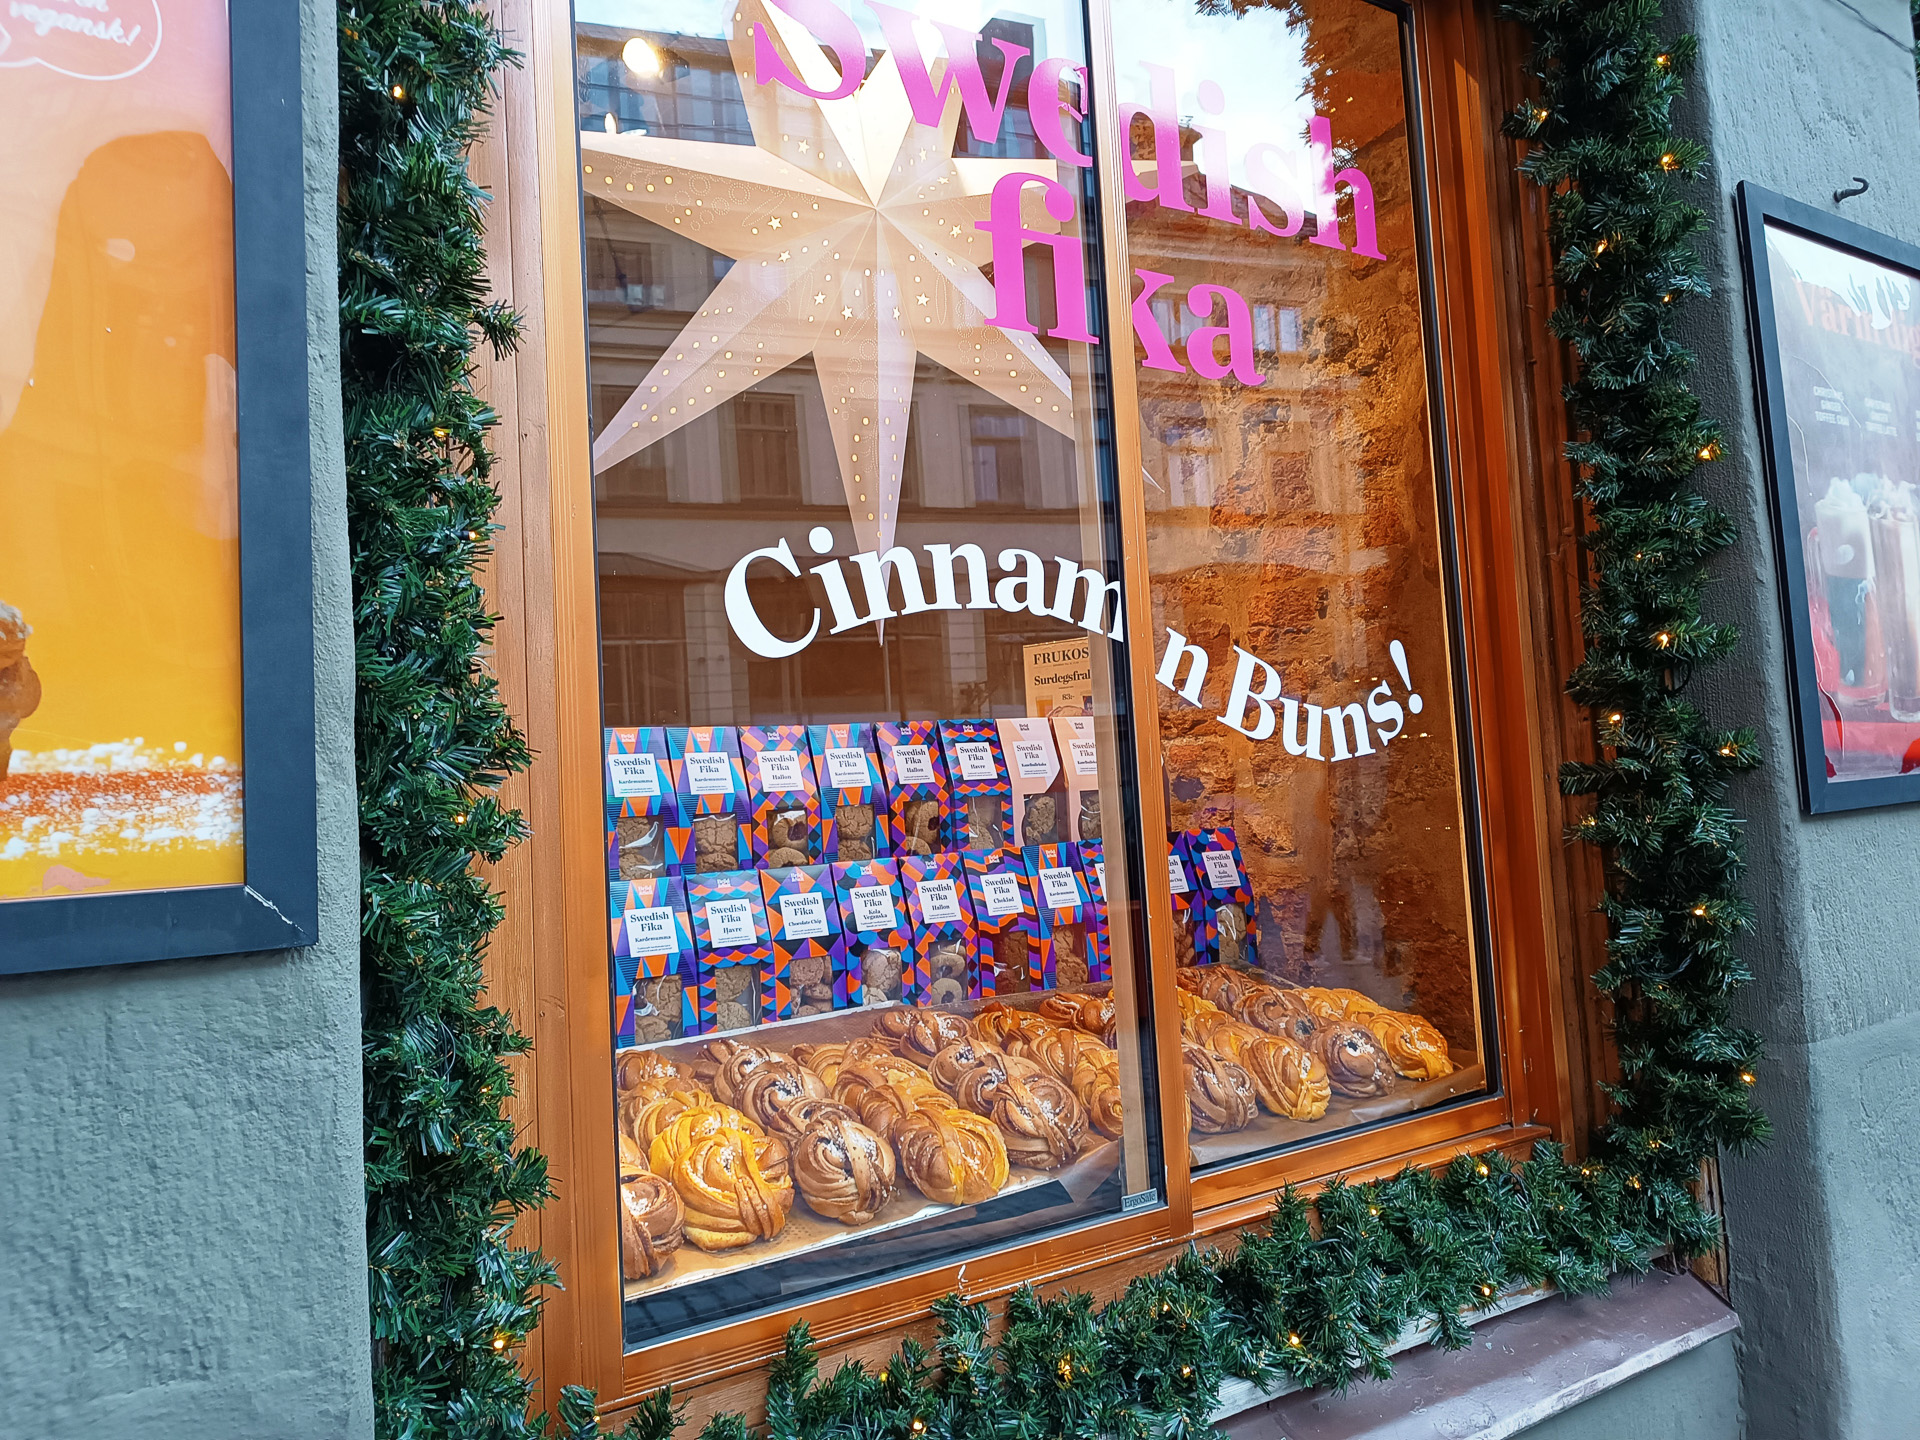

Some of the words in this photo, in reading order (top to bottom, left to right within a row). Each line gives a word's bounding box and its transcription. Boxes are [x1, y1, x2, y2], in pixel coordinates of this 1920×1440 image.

[754, 0, 1387, 260] Swedish
[975, 172, 1266, 386] fika
[724, 525, 1210, 708] Cinnamn
[1215, 639, 1423, 762] Buns!
[1033, 647, 1090, 666] FRUKOS
[1034, 669, 1091, 686] Surdegsfral
[896, 748, 926, 757] Swedish
[959, 745, 988, 753] Swedish
[1016, 744, 1043, 752] Swedish
[761, 754, 795, 763] Swedish
[829, 751, 862, 761] Swedish
[967, 753, 984, 761] Fika
[1024, 751, 1040, 759] Fika
[613, 757, 651, 767] Swedish
[690, 756, 725, 765] Swedish
[838, 759, 857, 769] Fika
[905, 756, 922, 765] Fika
[624, 765, 645, 775] Fika
[699, 764, 719, 774] Fika
[771, 763, 790, 772] Fika
[1205, 854, 1231, 862] Swedish
[1213, 861, 1228, 869] Fika
[1043, 872, 1071, 881] Swedish
[985, 877, 1014, 887] Swedish
[1051, 880, 1068, 888] Fika
[921, 883, 952, 893] Swedish
[993, 886, 1010, 895] Fika
[854, 888, 887, 899] Swedish
[929, 893, 948, 902] Fika
[784, 897, 819, 908] Swedish
[864, 899, 882, 908] Fika
[710, 903, 747, 915] Swedish
[794, 906, 814, 916] Fika
[630, 912, 669, 923] Swedish
[720, 914, 741, 924] Fika
[641, 922, 663, 932] Fika
